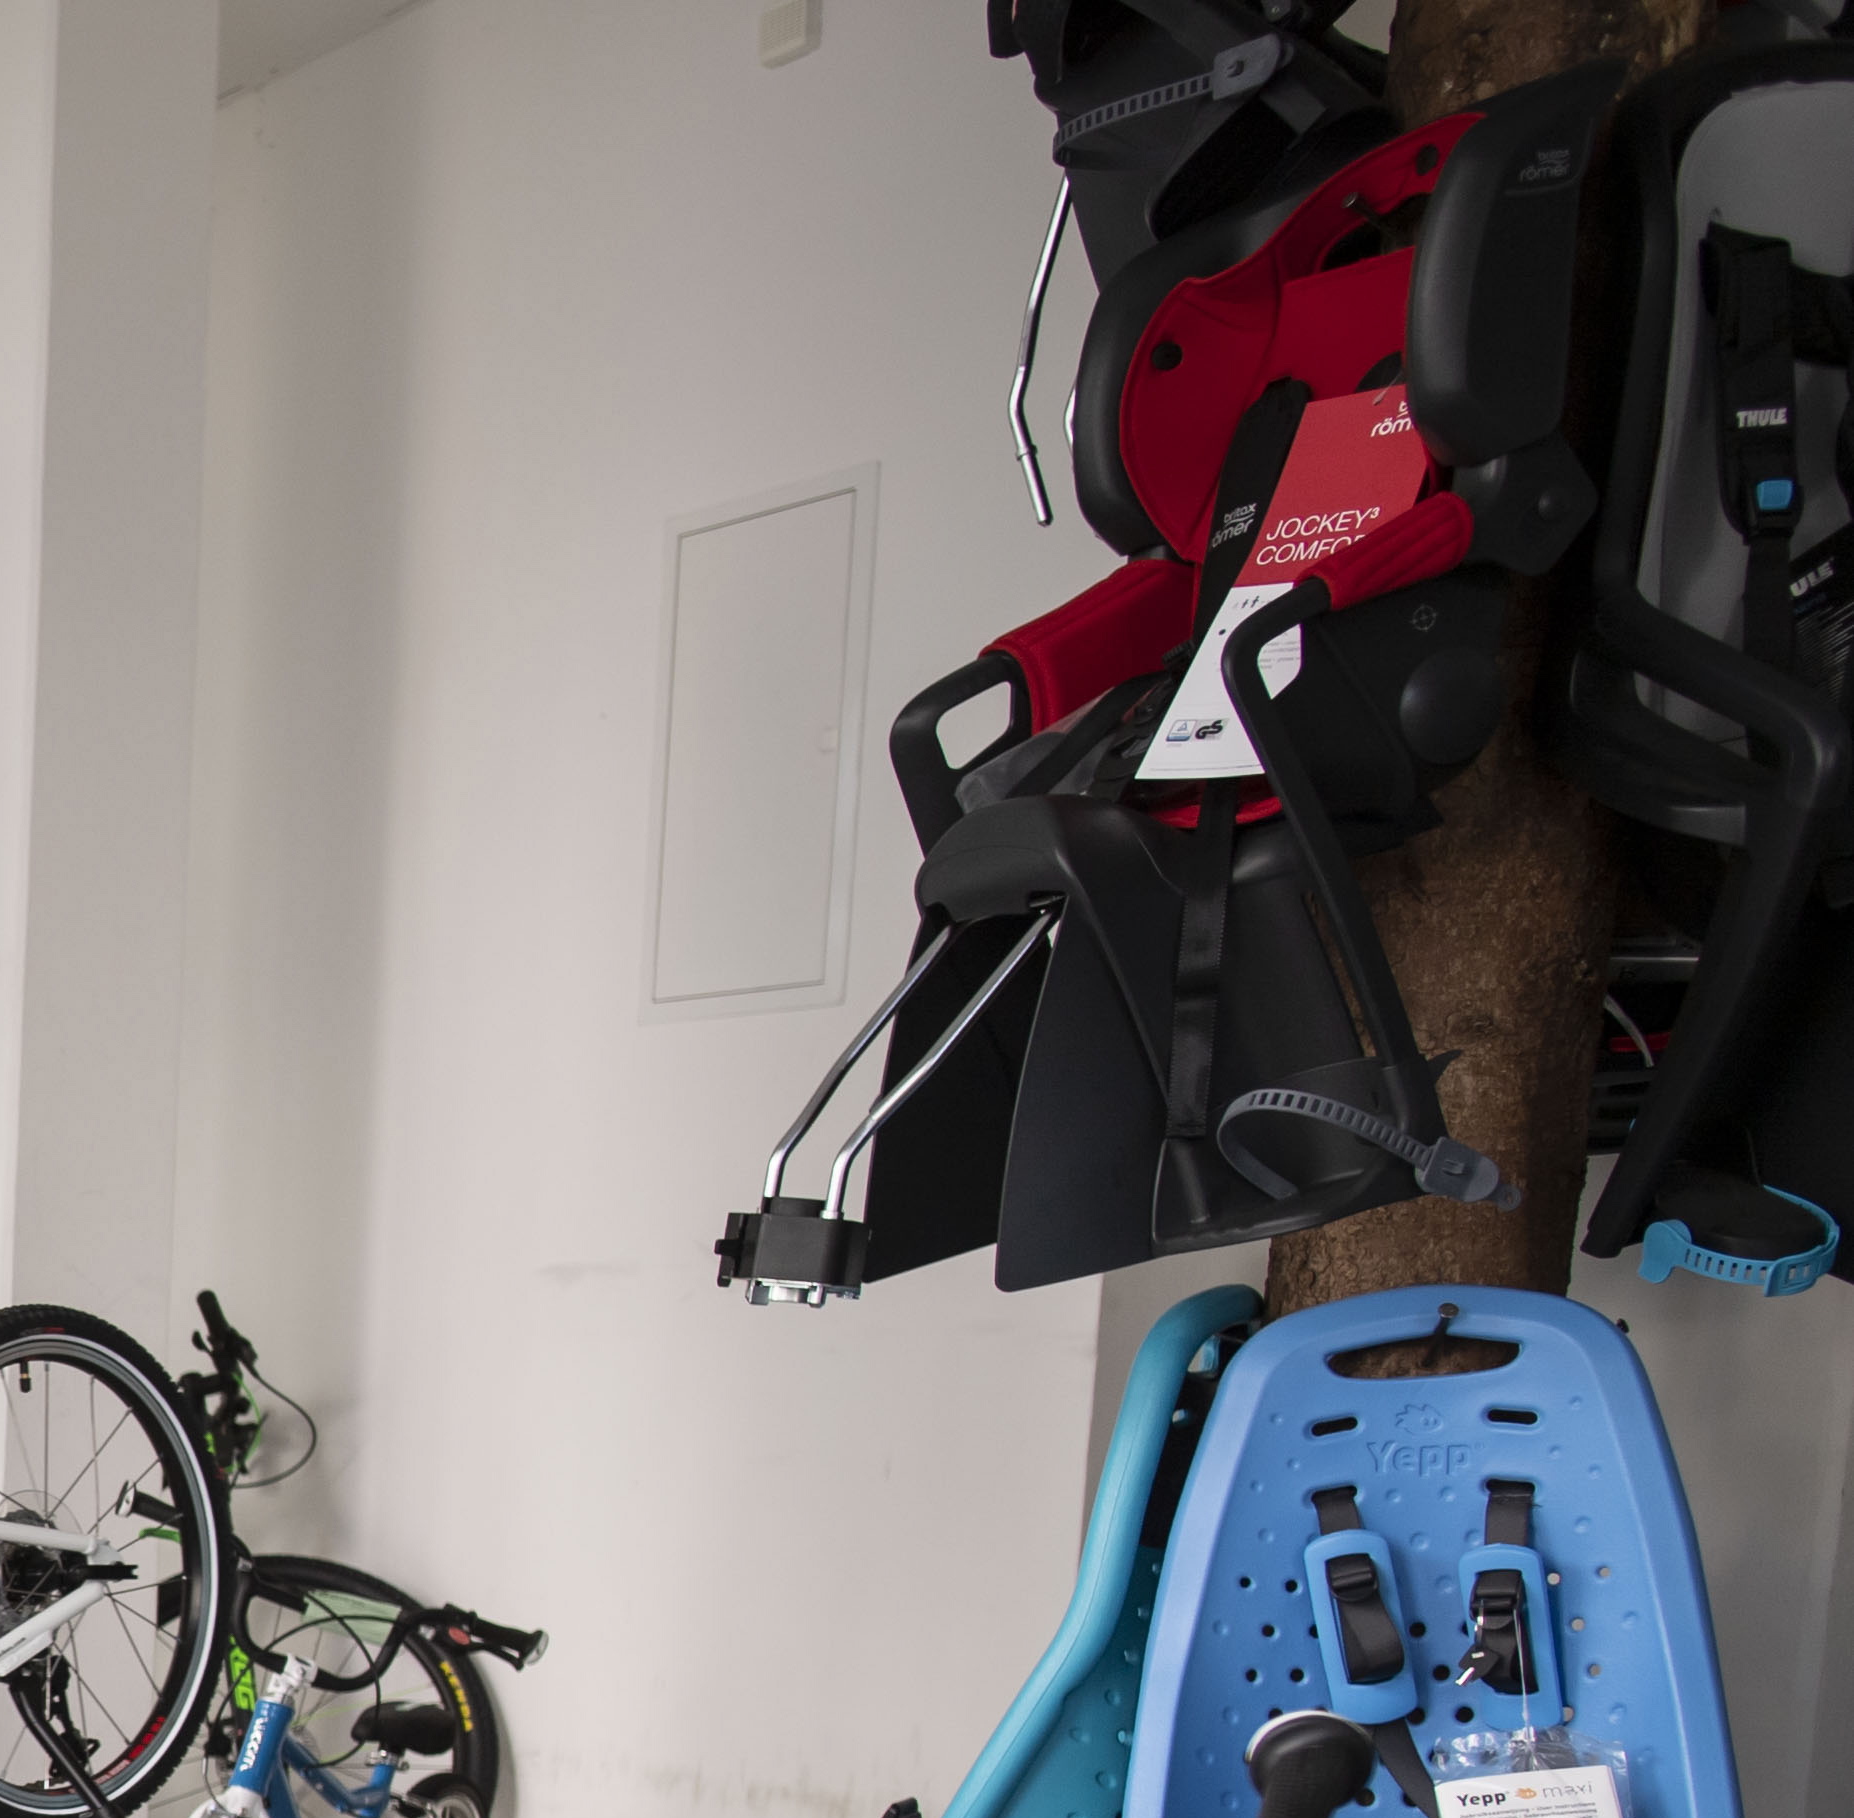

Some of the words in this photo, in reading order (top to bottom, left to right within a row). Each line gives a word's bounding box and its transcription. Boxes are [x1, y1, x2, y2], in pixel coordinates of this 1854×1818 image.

[1371, 417, 1414, 437] röm
[1736, 408, 1788, 429] THULE
[1223, 503, 1258, 523] britax
[1211, 517, 1255, 549] ömer
[1789, 560, 1835, 598] ULE
[1456, 1792, 1507, 1807] Yepp
